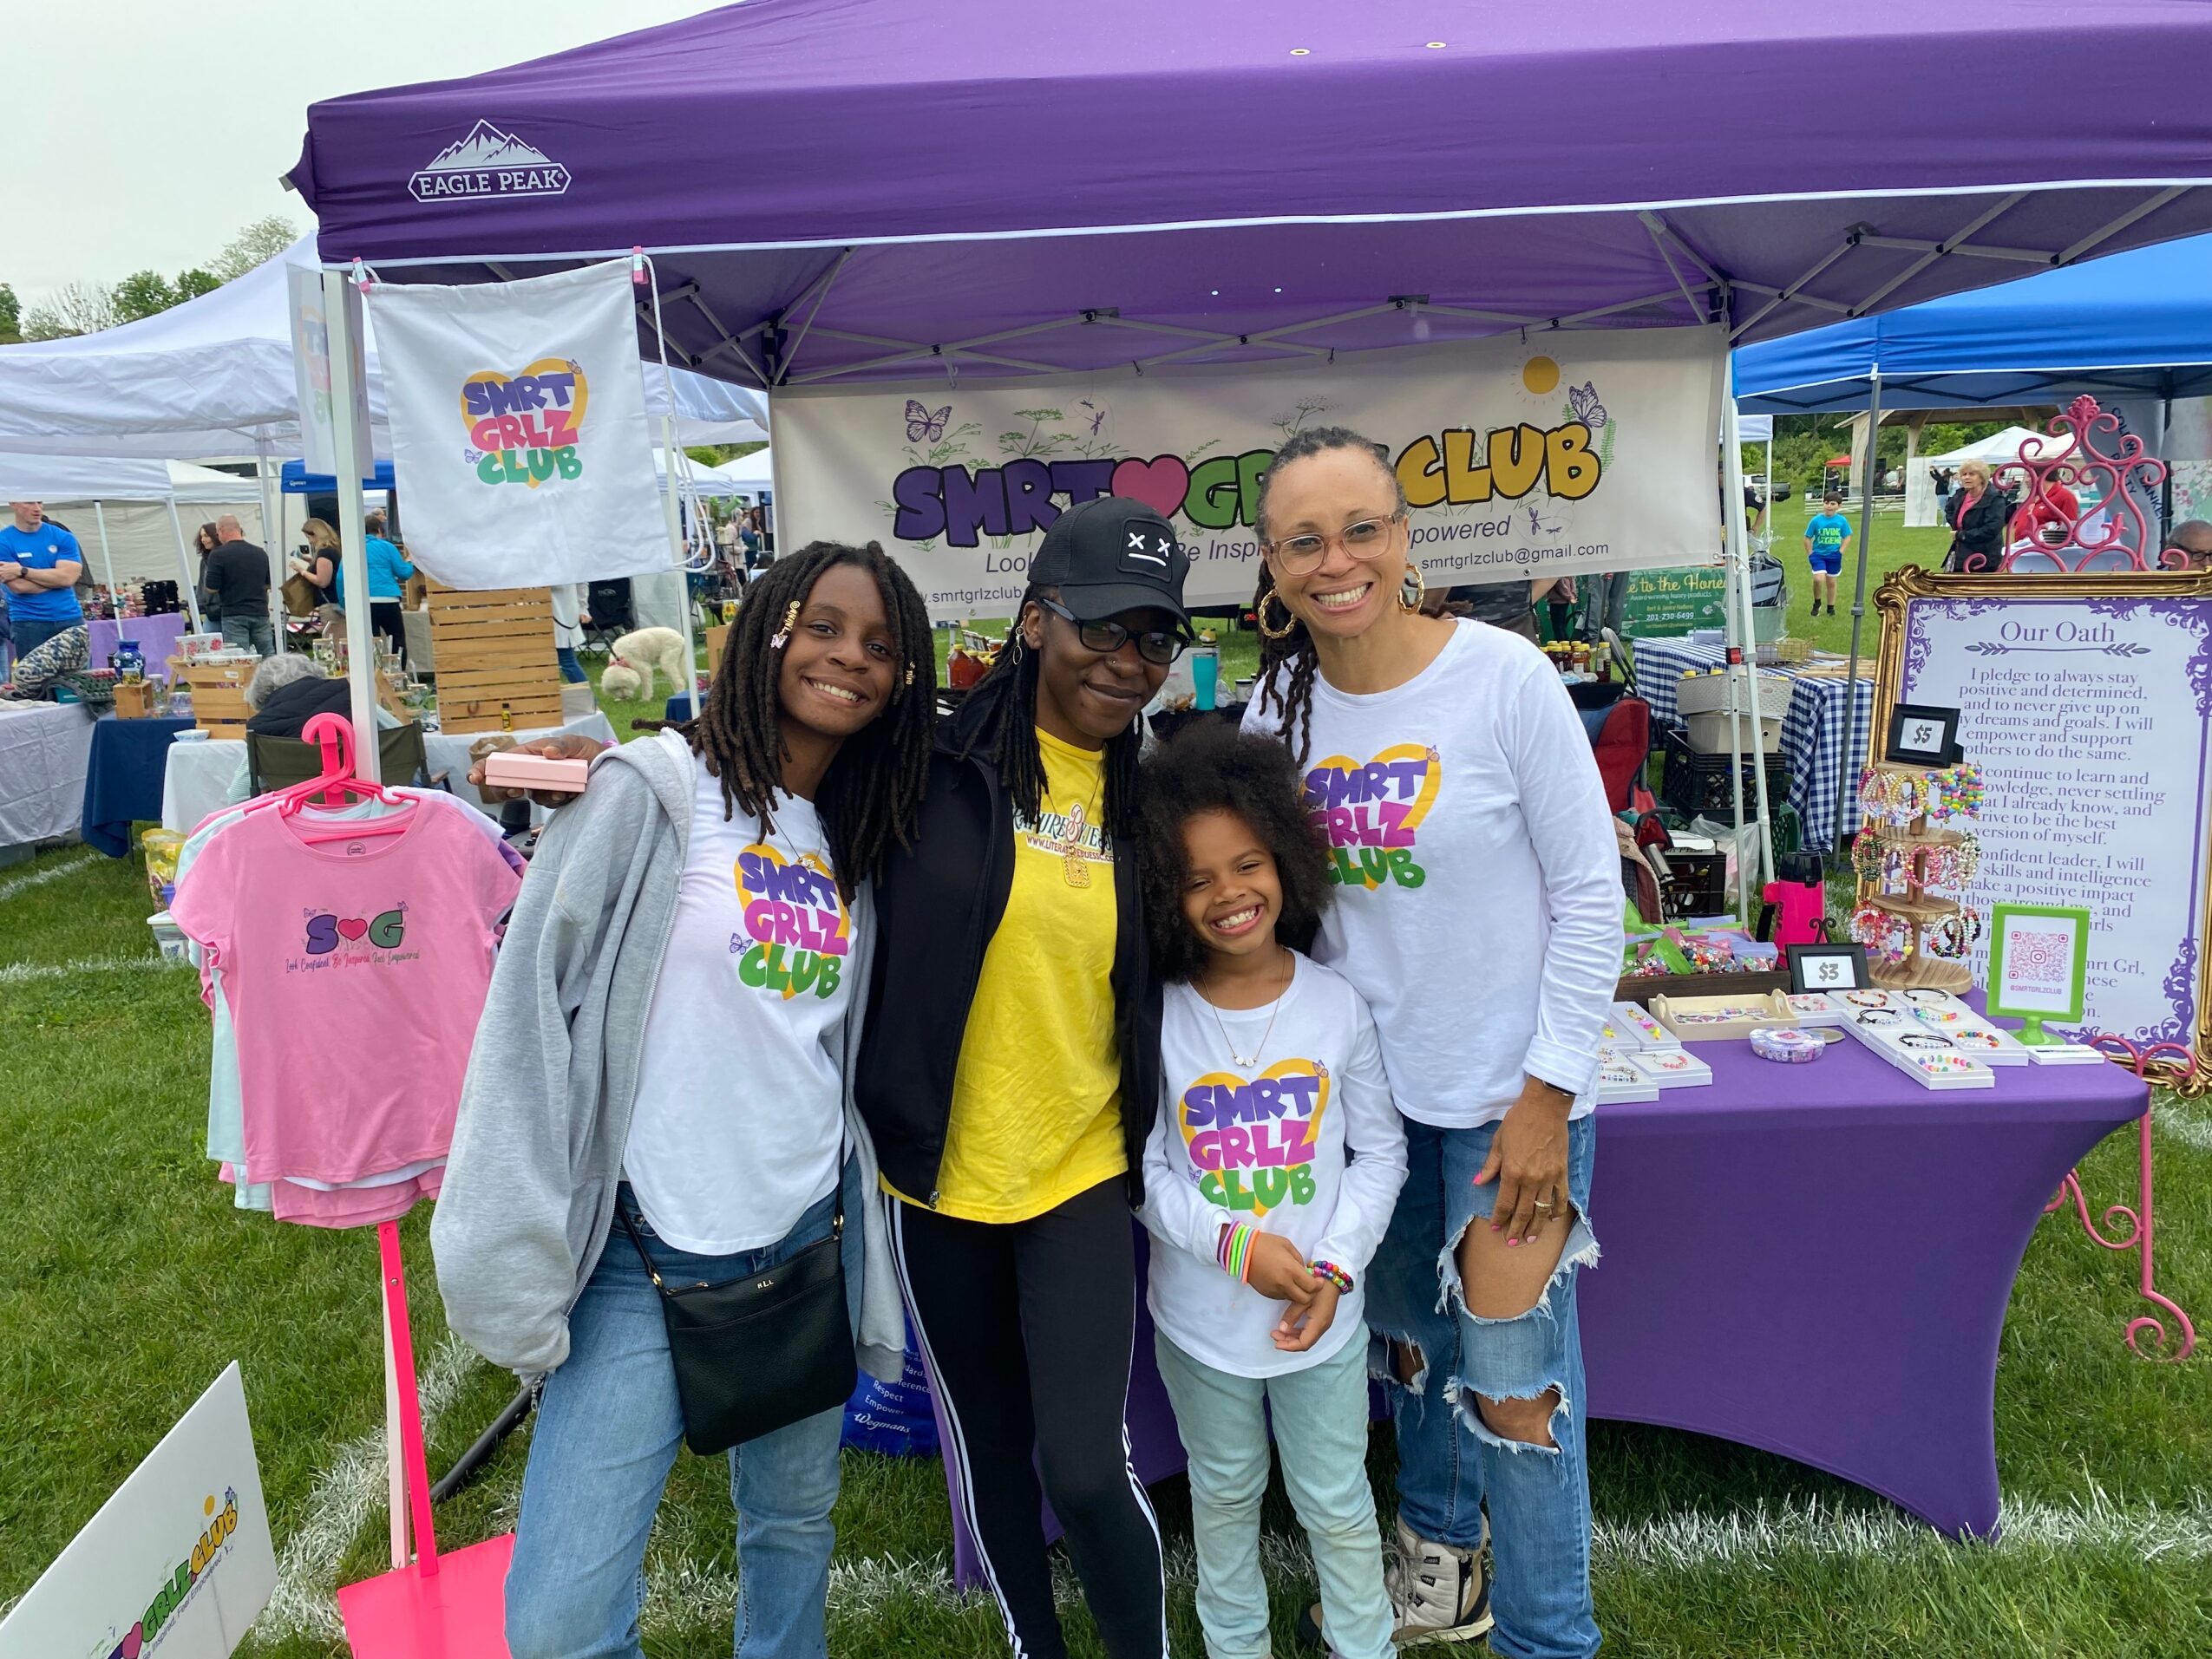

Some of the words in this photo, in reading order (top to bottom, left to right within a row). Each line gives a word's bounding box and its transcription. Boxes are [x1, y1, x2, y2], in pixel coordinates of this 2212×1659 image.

[418, 173, 491, 196] EAGLE
[462, 372, 575, 417] SMRT
[471, 408, 579, 452] GRLZ
[477, 446, 583, 485] CLUB
[893, 458, 1117, 548] SMRT
[1394, 421, 1602, 509] CLUB
[1407, 514, 1512, 550] powered
[1421, 543, 1609, 570] smrtgrlzclub@gmail.com
[1639, 577, 1656, 592] to
[1657, 576, 1681, 591] the
[1646, 611, 1694, 621] 201-230-6499
[2000, 620, 2049, 642] Our
[2055, 620, 2115, 643] Oath
[1971, 667, 1976, 680] I
[1980, 668, 2032, 685] pledge
[2035, 670, 2050, 682] to
[2053, 669, 2104, 687] always
[2108, 672, 2138, 688] stay
[1959, 683, 2017, 698] positive
[2020, 683, 2048, 696] and
[1964, 697, 1990, 710] and
[1995, 700, 2010, 711] to
[2014, 701, 2056, 712] never
[2059, 701, 2091, 715] give
[2095, 704, 2116, 717] up
[2119, 705, 2140, 715] on
[1975, 712, 2029, 727] dreams
[2032, 713, 2060, 728] and
[2064, 716, 2110, 731] goals.
[2115, 716, 2120, 729] I
[2125, 717, 2153, 731] will
[1913, 724, 1933, 744] $5
[1966, 729, 2036, 744] empower
[2039, 730, 2066, 743] and
[2071, 734, 2134, 748] support
[1965, 742, 2012, 755] others
[2016, 746, 2031, 757] to
[2034, 744, 2054, 758] do
[2058, 745, 2083, 759] the
[2086, 749, 2131, 761] same.
[1303, 760, 1429, 810] SMRT
[1985, 767, 2052, 781] continue
[2057, 769, 2072, 782] to
[2076, 768, 2115, 783] learn
[2119, 772, 2150, 786] and
[1985, 782, 2052, 797] owledge,
[2058, 788, 2101, 798] never
[2104, 787, 2166, 805] settling
[2003, 795, 2008, 808] I
[2012, 797, 2065, 813] already
[2071, 799, 2118, 815] know,
[2123, 802, 2152, 817] and
[2013, 813, 2028, 825] to
[2032, 812, 2051, 826] be
[2055, 813, 2080, 828] the
[2084, 813, 2117, 830] best
[1973, 826, 2029, 840] version
[2032, 827, 2050, 841] of
[2053, 831, 2107, 847] myself.
[1980, 849, 2043, 865] onfident
[2106, 855, 2111, 868] I
[2117, 857, 2144, 871] will
[738, 852, 837, 911] SMRT
[1983, 863, 2022, 878] skills
[2025, 865, 2054, 880] and
[2058, 866, 2152, 888] intelligence
[2004, 884, 2012, 892] a
[2016, 882, 2078, 898] positive
[2081, 885, 2135, 904] impact
[1966, 892, 2006, 907] those
[2103, 904, 2131, 918] and
[744, 898, 848, 957] GRLZ
[2089, 918, 2113, 932] irls
[301, 957, 330, 972] Confident
[344, 953, 370, 968] Inspired
[388, 950, 420, 965] Empowered
[738, 943, 841, 1000] CLUB
[1818, 962, 1839, 982] $3
[2113, 958, 2145, 976] Grl,
[2010, 985, 2062, 995] @SMRTGRLZCLUB
[1184, 1076, 1319, 1131] SMRT
[1189, 1119, 1315, 1171] GRLZ
[1199, 1163, 1316, 1211] CLUB
[756, 1279, 775, 1290] RLL
[873, 1380, 904, 1402] Respect
[865, 1394, 905, 1415] Empower
[854, 1413, 911, 1434] Wegmans
[142, 1558, 193, 1643] GRLZ
[190, 1502, 238, 1576] CLUB
[177, 1595, 190, 1618] Feel
[190, 1552, 223, 1601] Empowered
